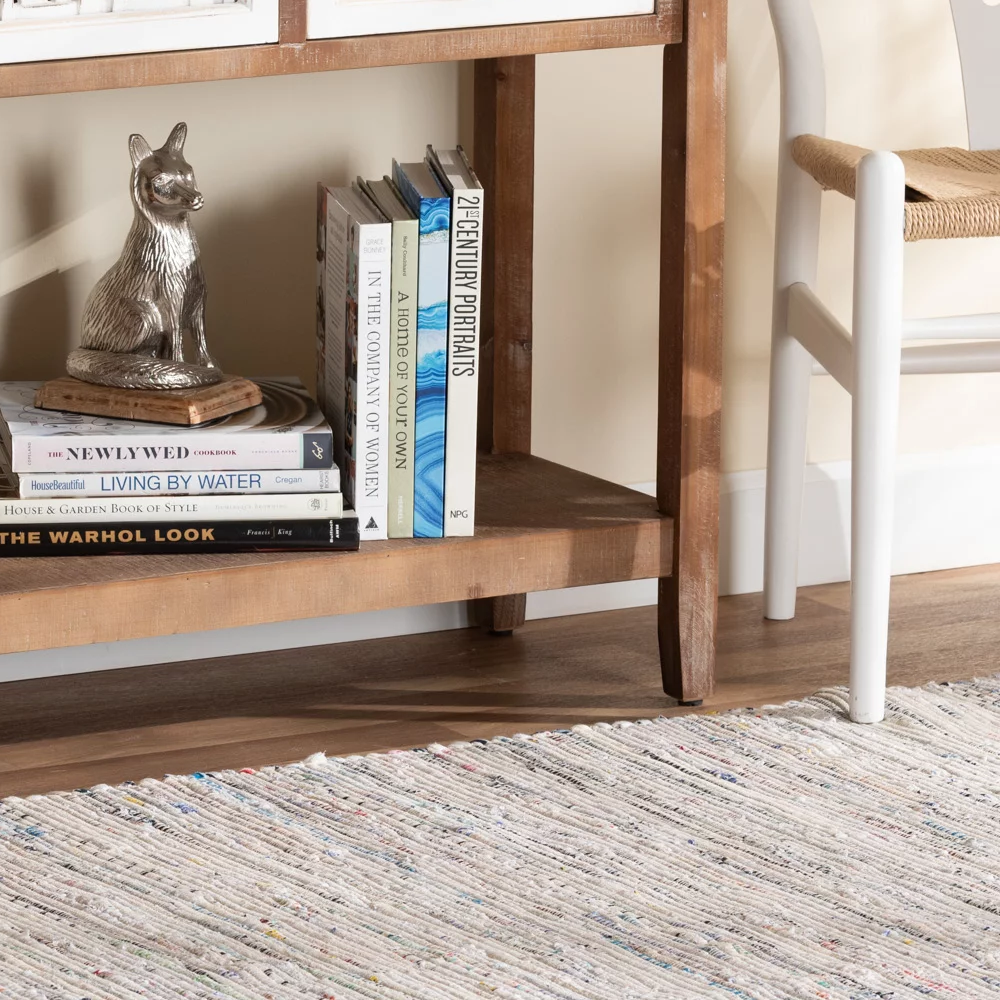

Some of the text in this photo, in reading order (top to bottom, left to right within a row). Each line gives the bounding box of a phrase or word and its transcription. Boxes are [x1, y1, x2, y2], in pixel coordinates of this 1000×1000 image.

[398, 291, 409, 303] A
[452, 294, 477, 377] PORTRAITS
[365, 271, 381, 498] IN THE COMPANY OF WOMEN
[66, 446, 190, 461] NEWLYWED
[395, 431, 407, 470] OWN
[101, 473, 261, 491] LIVING BY WATER
[275, 476, 303, 485] Cregan
[46, 505, 56, 515] &
[450, 509, 469, 520] NPG
[48, 529, 147, 544] WARHOL
[154, 528, 215, 542] LOOK
[277, 528, 293, 536] King
